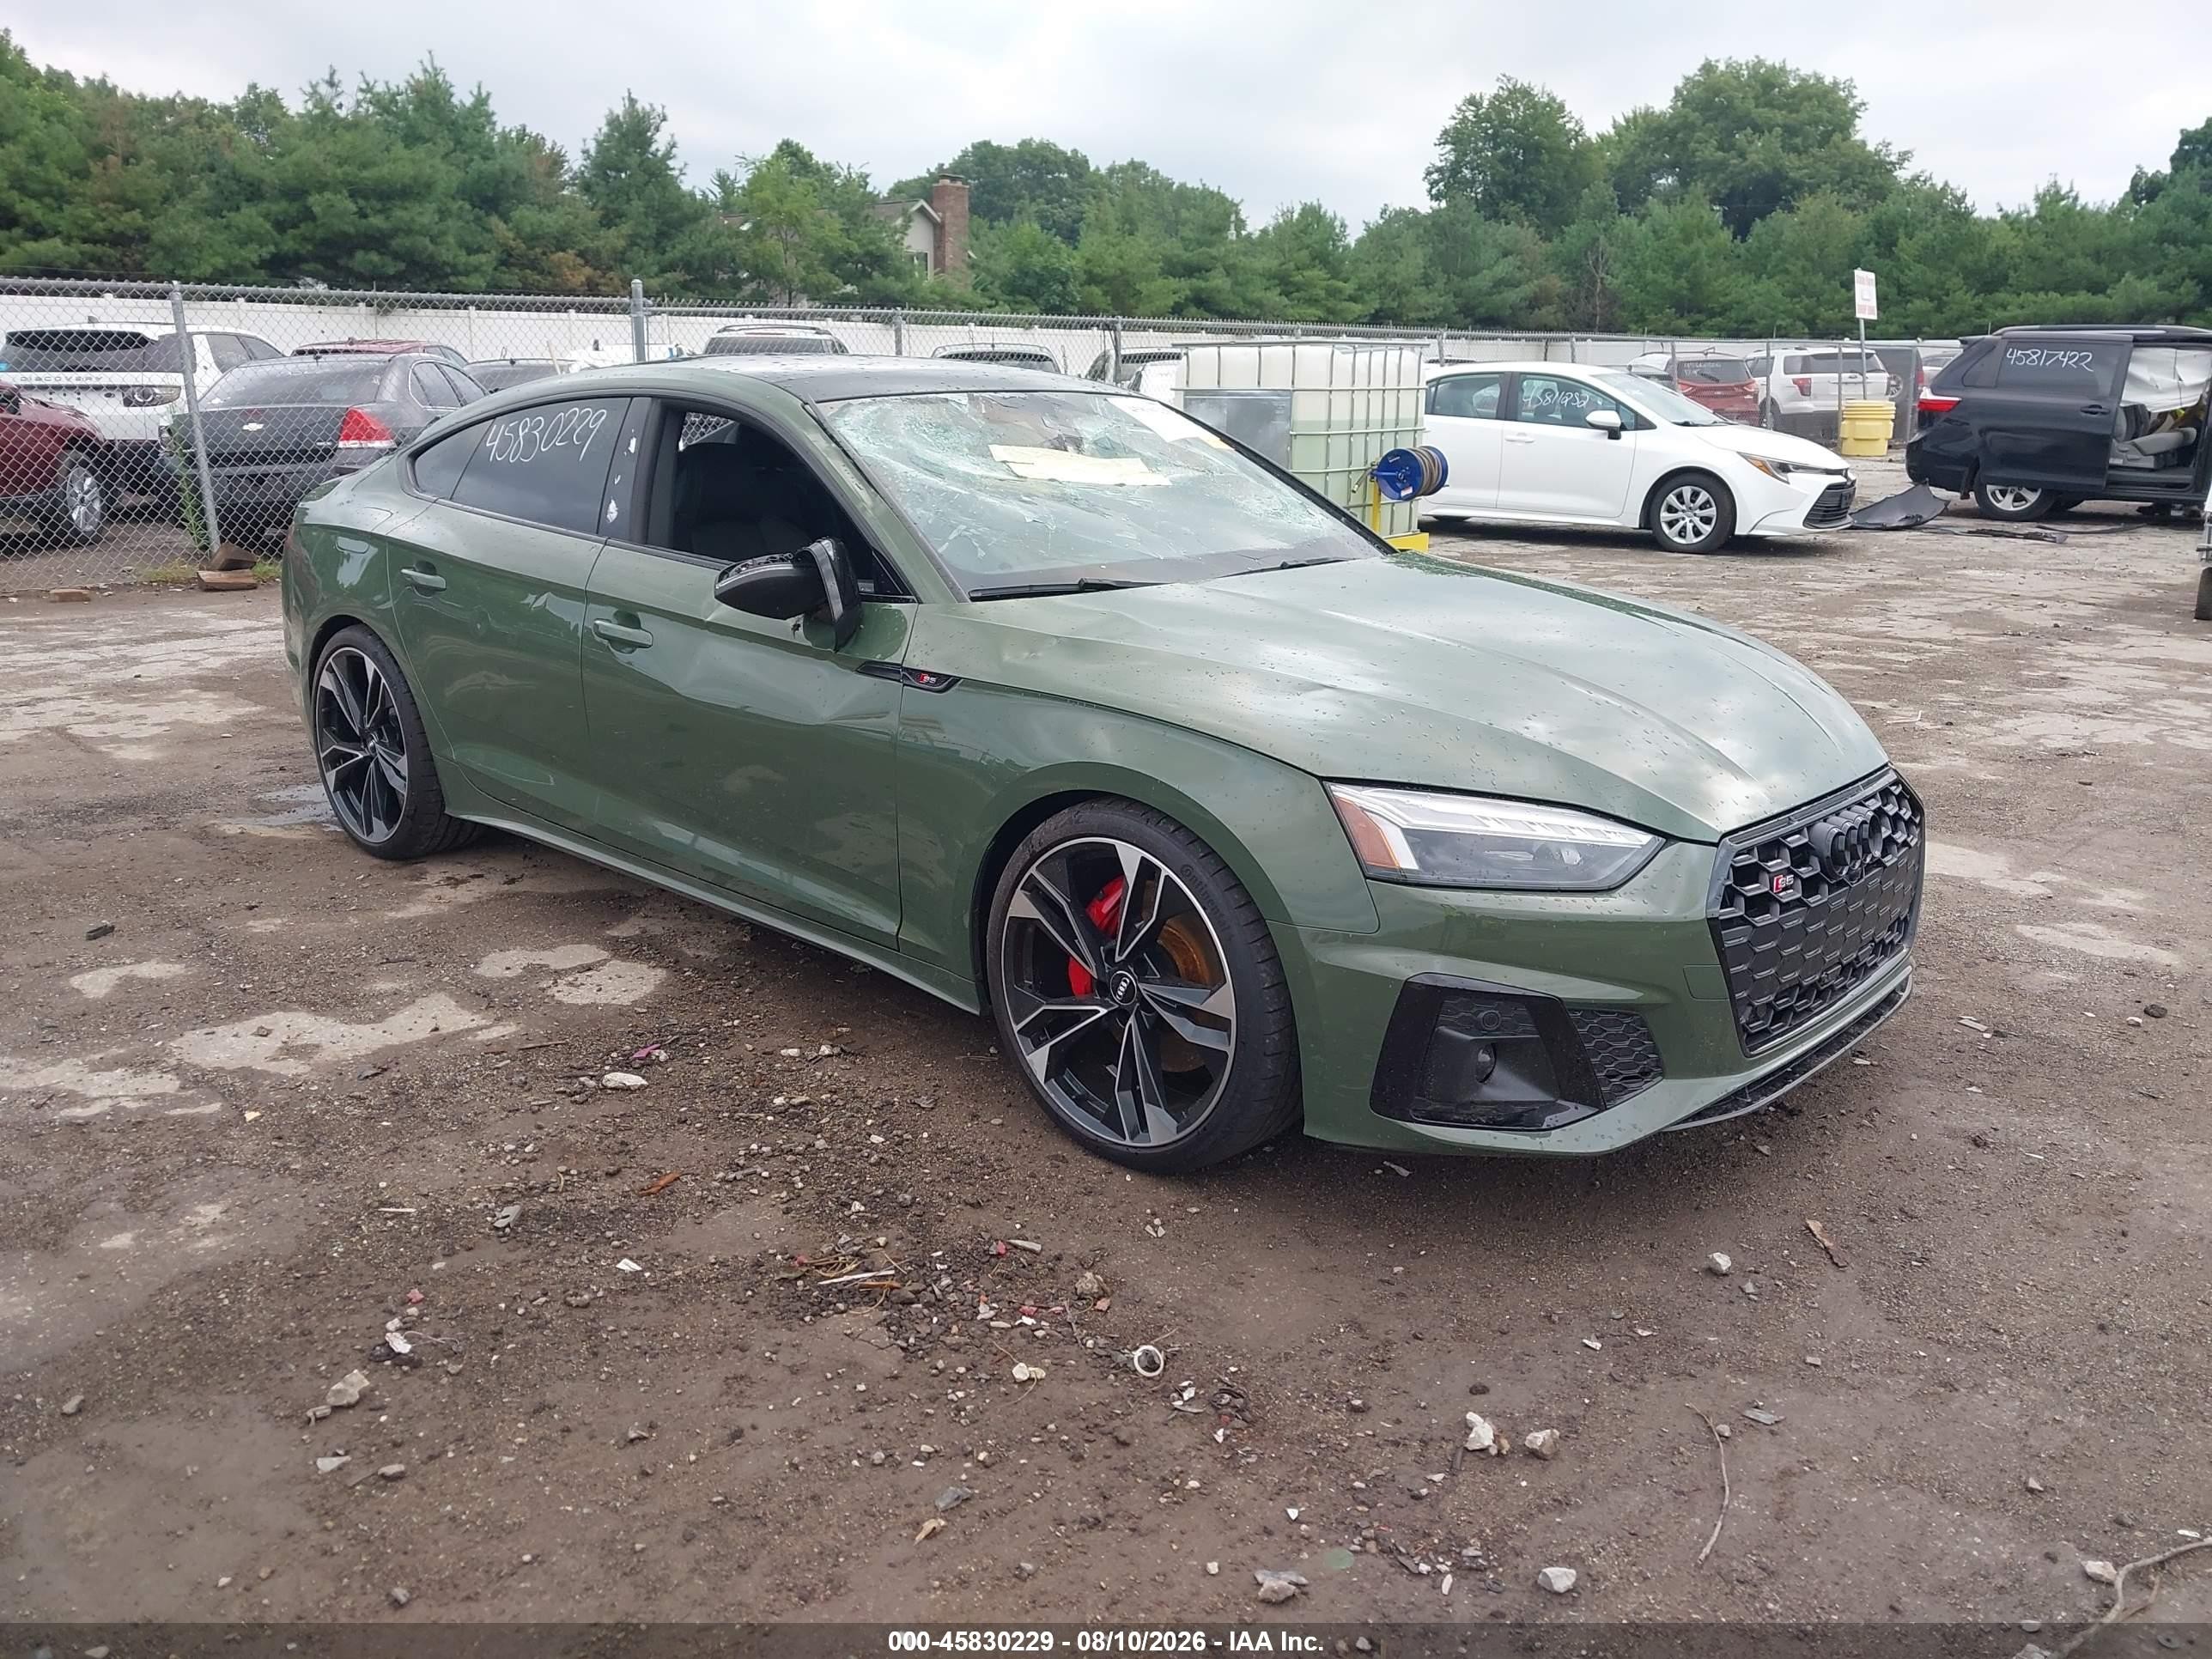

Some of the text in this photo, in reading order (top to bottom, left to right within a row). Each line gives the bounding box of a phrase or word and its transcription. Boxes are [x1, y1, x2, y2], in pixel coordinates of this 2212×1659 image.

[2007, 348, 2094, 372] 45817422
[486, 407, 607, 463] 45830229
[1775, 875, 1794, 891] S5
